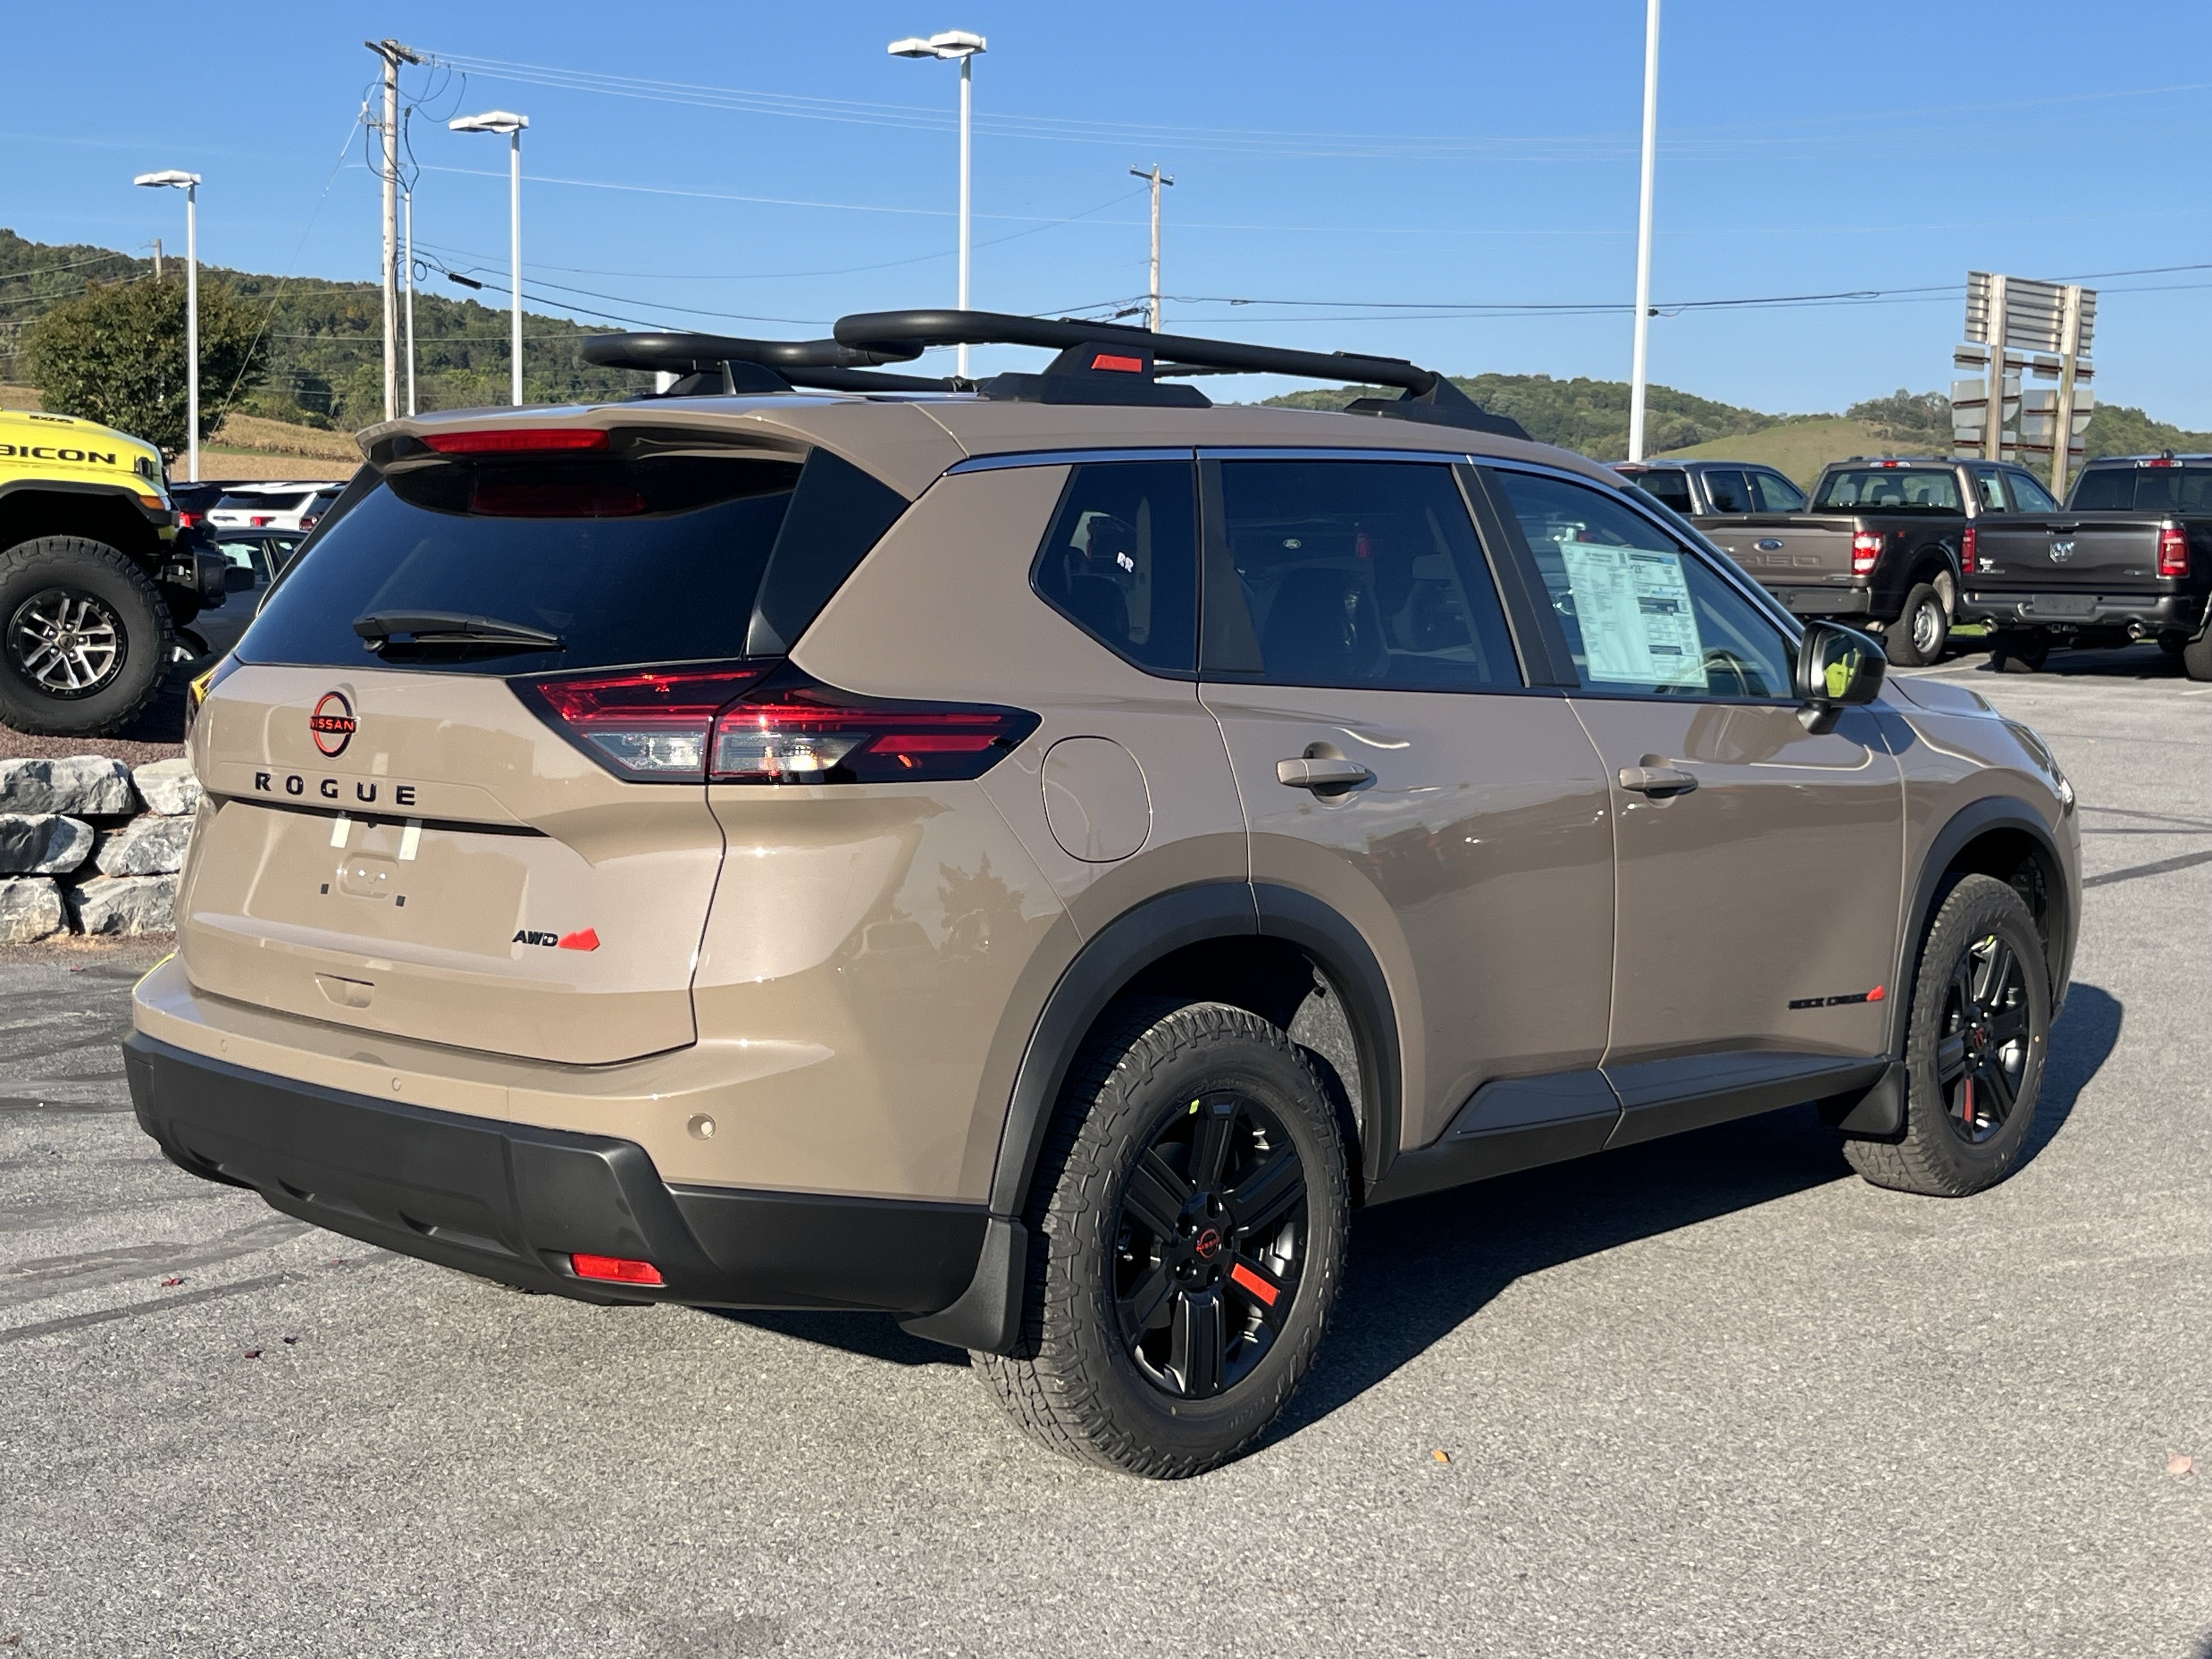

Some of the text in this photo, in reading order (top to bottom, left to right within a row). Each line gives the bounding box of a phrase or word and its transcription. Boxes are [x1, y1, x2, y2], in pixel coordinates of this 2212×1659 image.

[309, 718, 355, 731] NISSAN
[255, 771, 416, 806] ROGUE
[511, 929, 558, 947] AWD
